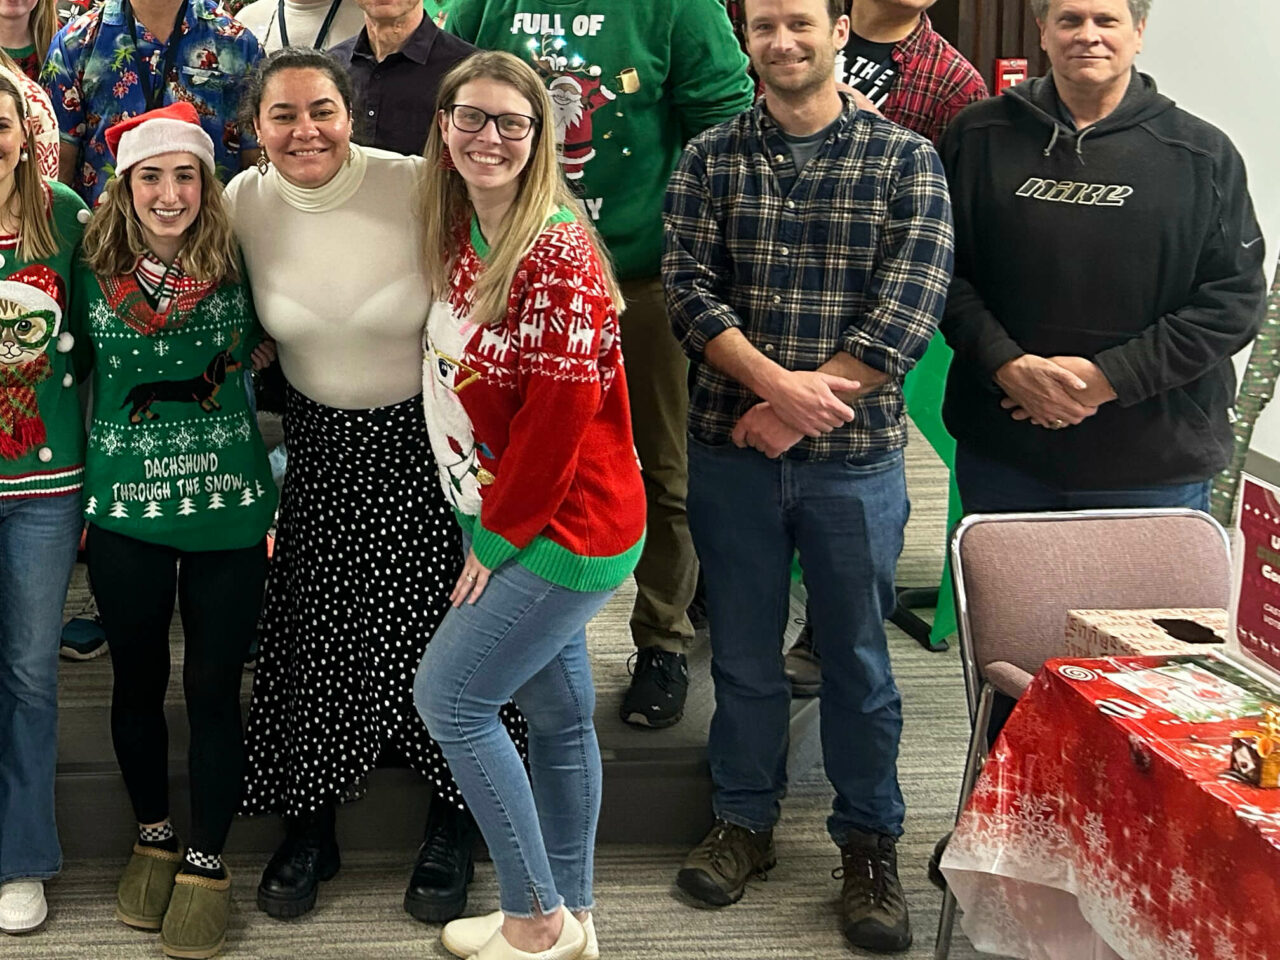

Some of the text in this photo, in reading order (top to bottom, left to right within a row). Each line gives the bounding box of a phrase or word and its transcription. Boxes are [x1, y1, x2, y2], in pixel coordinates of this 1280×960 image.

[510, 13, 605, 36] FULL OF
[850, 56, 894, 86] THE
[144, 452, 218, 479] DACHSHUND
[112, 481, 171, 502] THROUGH
[176, 476, 201, 497] THE
